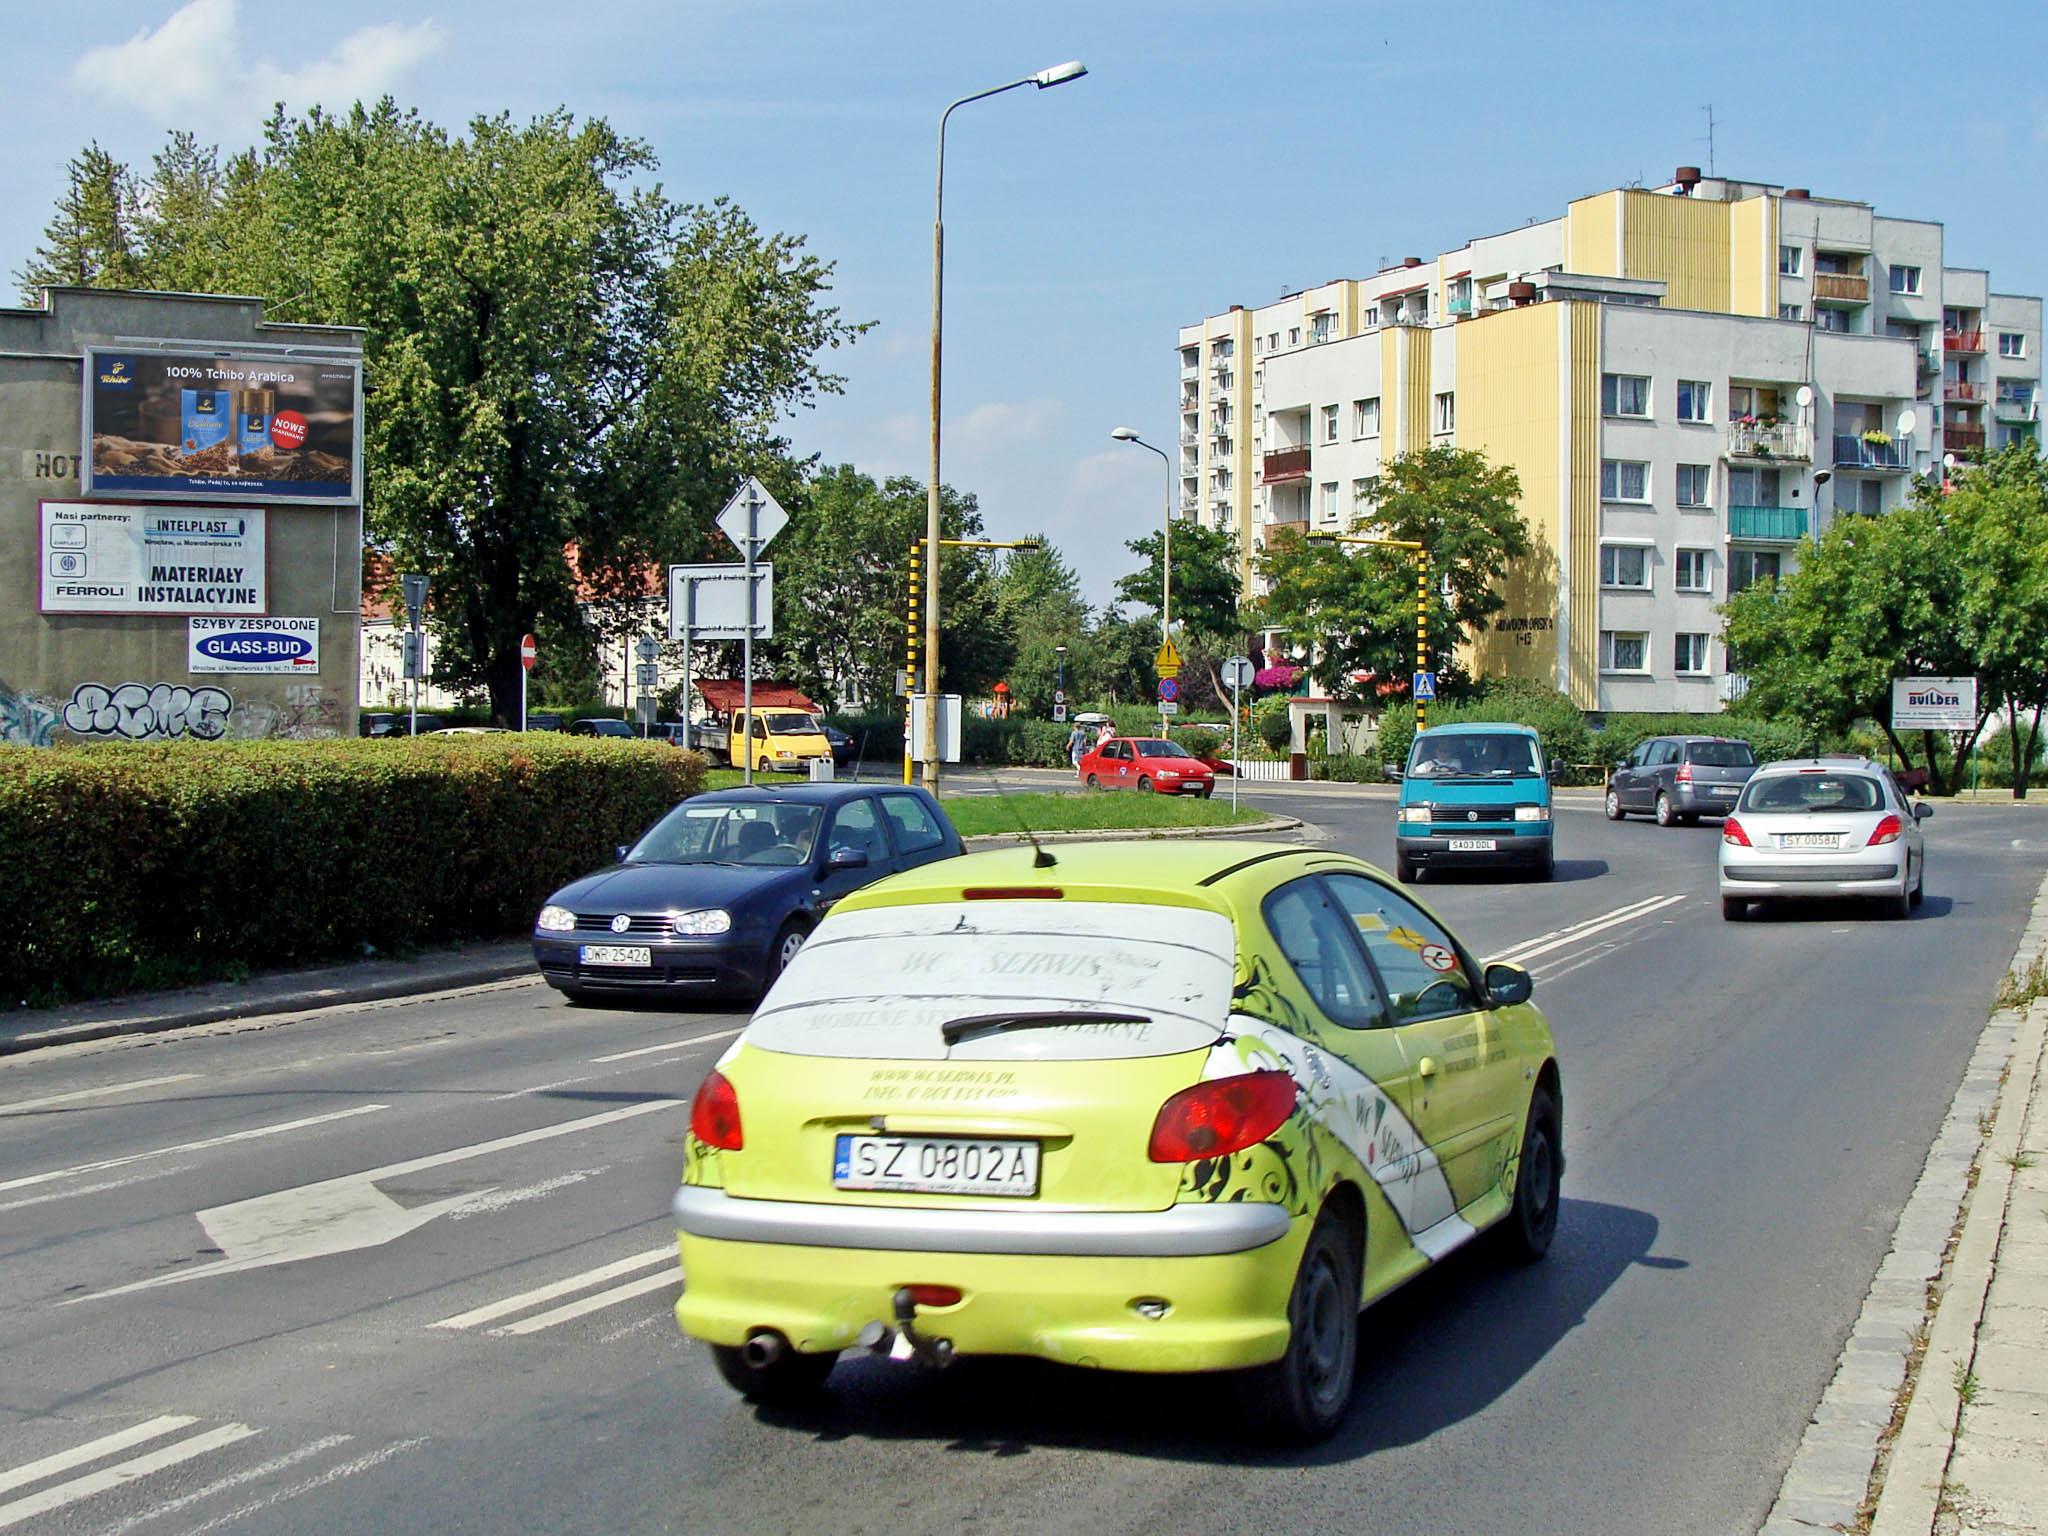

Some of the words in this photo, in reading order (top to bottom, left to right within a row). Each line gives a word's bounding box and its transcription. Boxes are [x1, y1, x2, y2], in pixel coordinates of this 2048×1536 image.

[166, 366, 202, 379] 100%
[206, 368, 245, 380] Tchibo
[248, 370, 295, 383] Arabica
[275, 418, 305, 434] NOWE
[55, 511, 78, 520] Nasi
[80, 512, 131, 523] partnerzy:
[157, 519, 228, 533] INTELPLAST
[151, 565, 245, 584] MATERIAŁY
[56, 585, 125, 597] FERROLI
[138, 586, 257, 604] INSTALACYJNE
[192, 618, 236, 630] SZYBY
[239, 619, 316, 631] ZESPOLONE
[207, 639, 302, 655] GLASS-BUD
[1908, 691, 1960, 706] BUILDER
[612, 948, 650, 963] 25426
[857, 1141, 907, 1178] SZ
[919, 1142, 1028, 1183] 0802A
